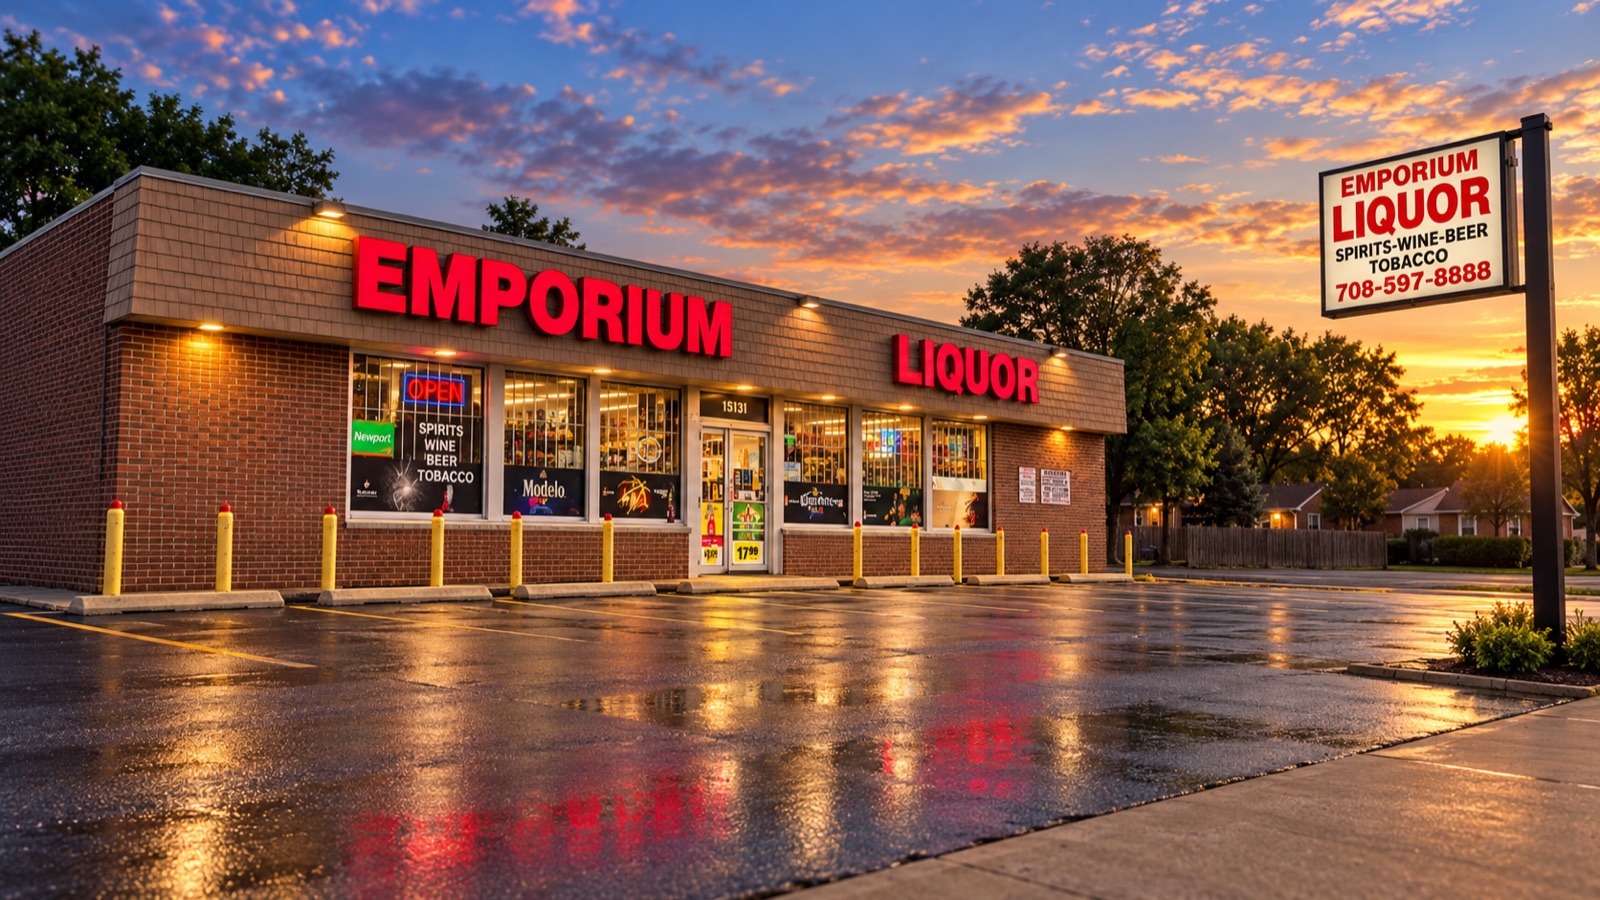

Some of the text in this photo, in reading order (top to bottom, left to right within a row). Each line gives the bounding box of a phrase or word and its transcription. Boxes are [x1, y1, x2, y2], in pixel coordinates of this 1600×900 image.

[1341, 149, 1478, 198] EMPORIUM
[1333, 176, 1491, 243] LIQUOR
[1336, 223, 1488, 262] SPIRITS-WINE-BEER
[1369, 248, 1448, 274] TOBACCO
[1336, 261, 1491, 302] 708-597-8888
[353, 235, 732, 358] EMPORIUM
[892, 333, 1040, 404] LIQUOR
[407, 378, 463, 404] OPEN
[722, 400, 747, 414] 15131
[354, 431, 391, 444] Newport
[419, 422, 464, 437] SPIRITS
[424, 438, 456, 452] WINE
[426, 453, 458, 467] BEER
[417, 469, 474, 484] TOBACCO
[522, 479, 565, 499] Modelo
